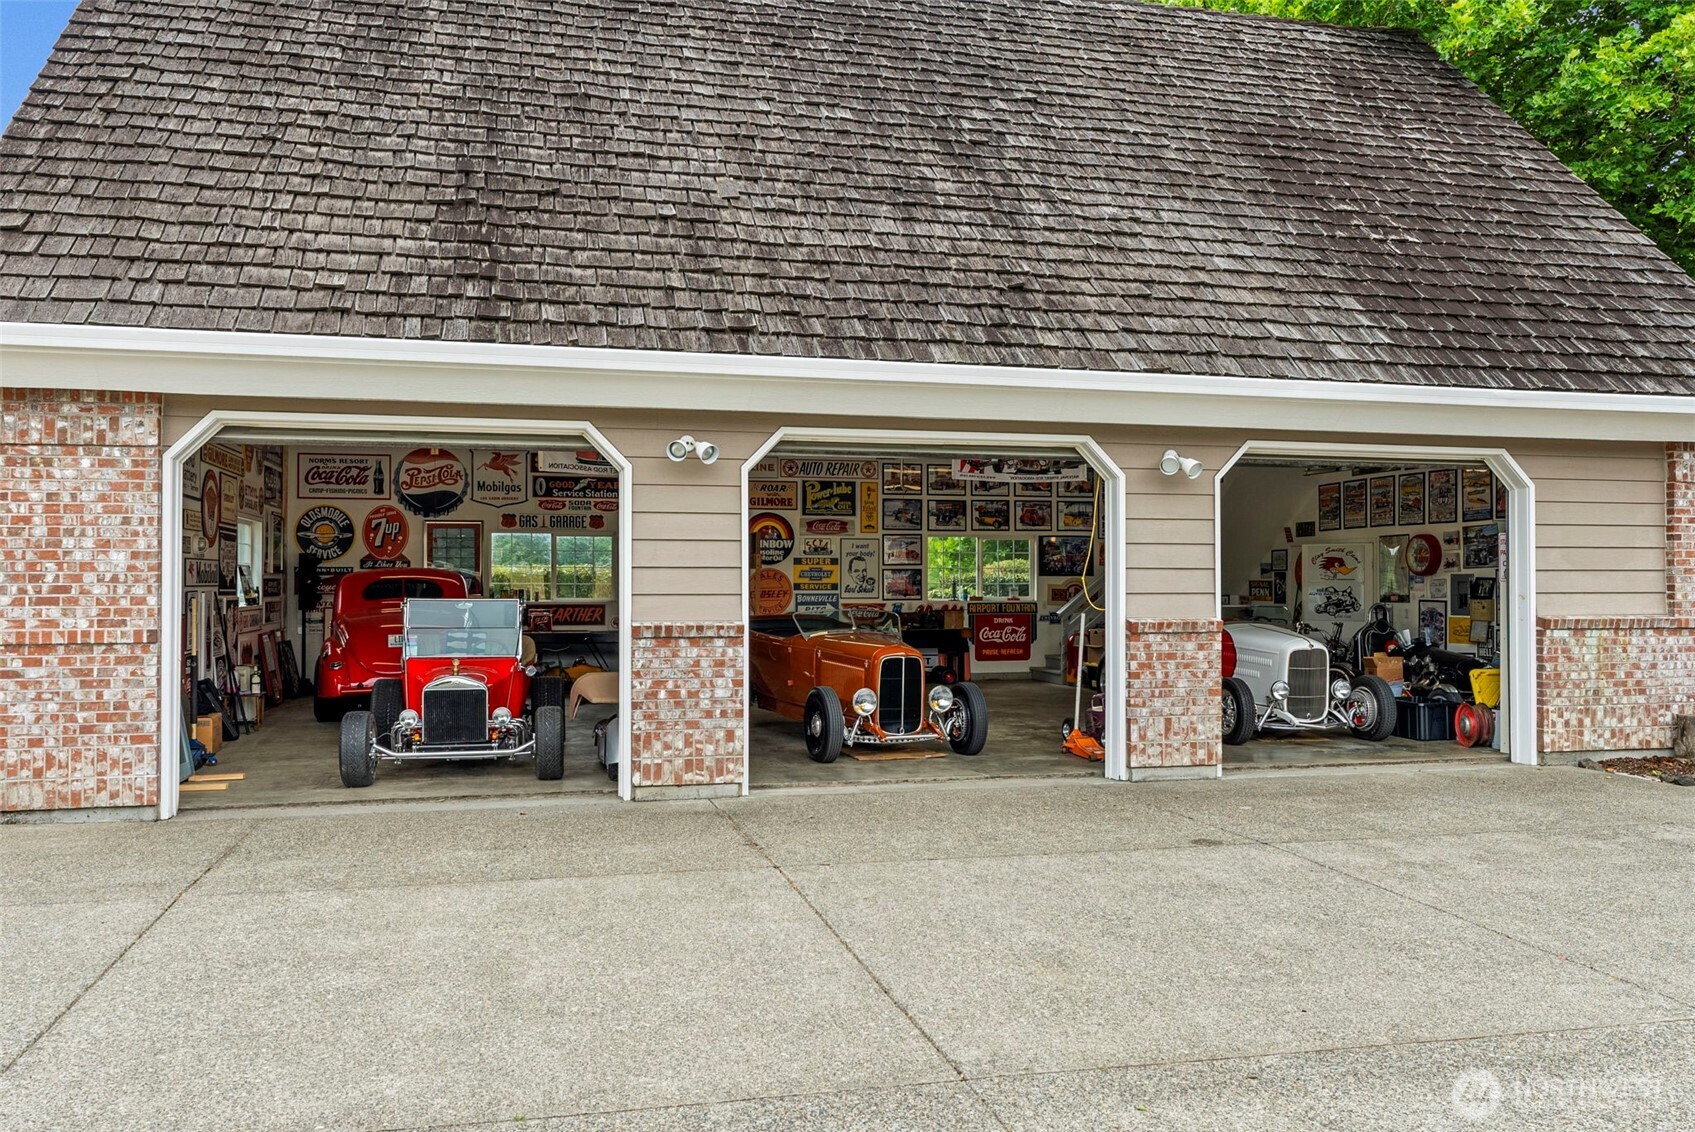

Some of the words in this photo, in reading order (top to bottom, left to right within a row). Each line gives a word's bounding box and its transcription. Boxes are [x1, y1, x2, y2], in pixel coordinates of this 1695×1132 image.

[304, 465, 373, 485] Coca-Cola
[799, 462, 824, 476] AUTO
[825, 462, 860, 476] REPAIR
[477, 480, 522, 495] Mobilgas
[549, 480, 575, 489] GOOD
[760, 484, 787, 492] ROAR
[552, 489, 583, 498] Service
[585, 489, 619, 499] Station
[750, 497, 794, 507] GILMORE
[300, 506, 350, 530] OLDSMOBILE
[519, 514, 538, 528] GAS
[549, 515, 588, 529] GARAGE
[760, 539, 794, 549] INBOW
[306, 544, 343, 560] SERVICE
[797, 594, 839, 603] BONNEVILLE
[1250, 588, 1270, 597] PENN
[551, 607, 604, 623] ARTHER
[969, 603, 1001, 613] AIRPORT
[1002, 603, 1037, 613] FOUNTAIN
[979, 625, 1028, 643] Coca-Cola
